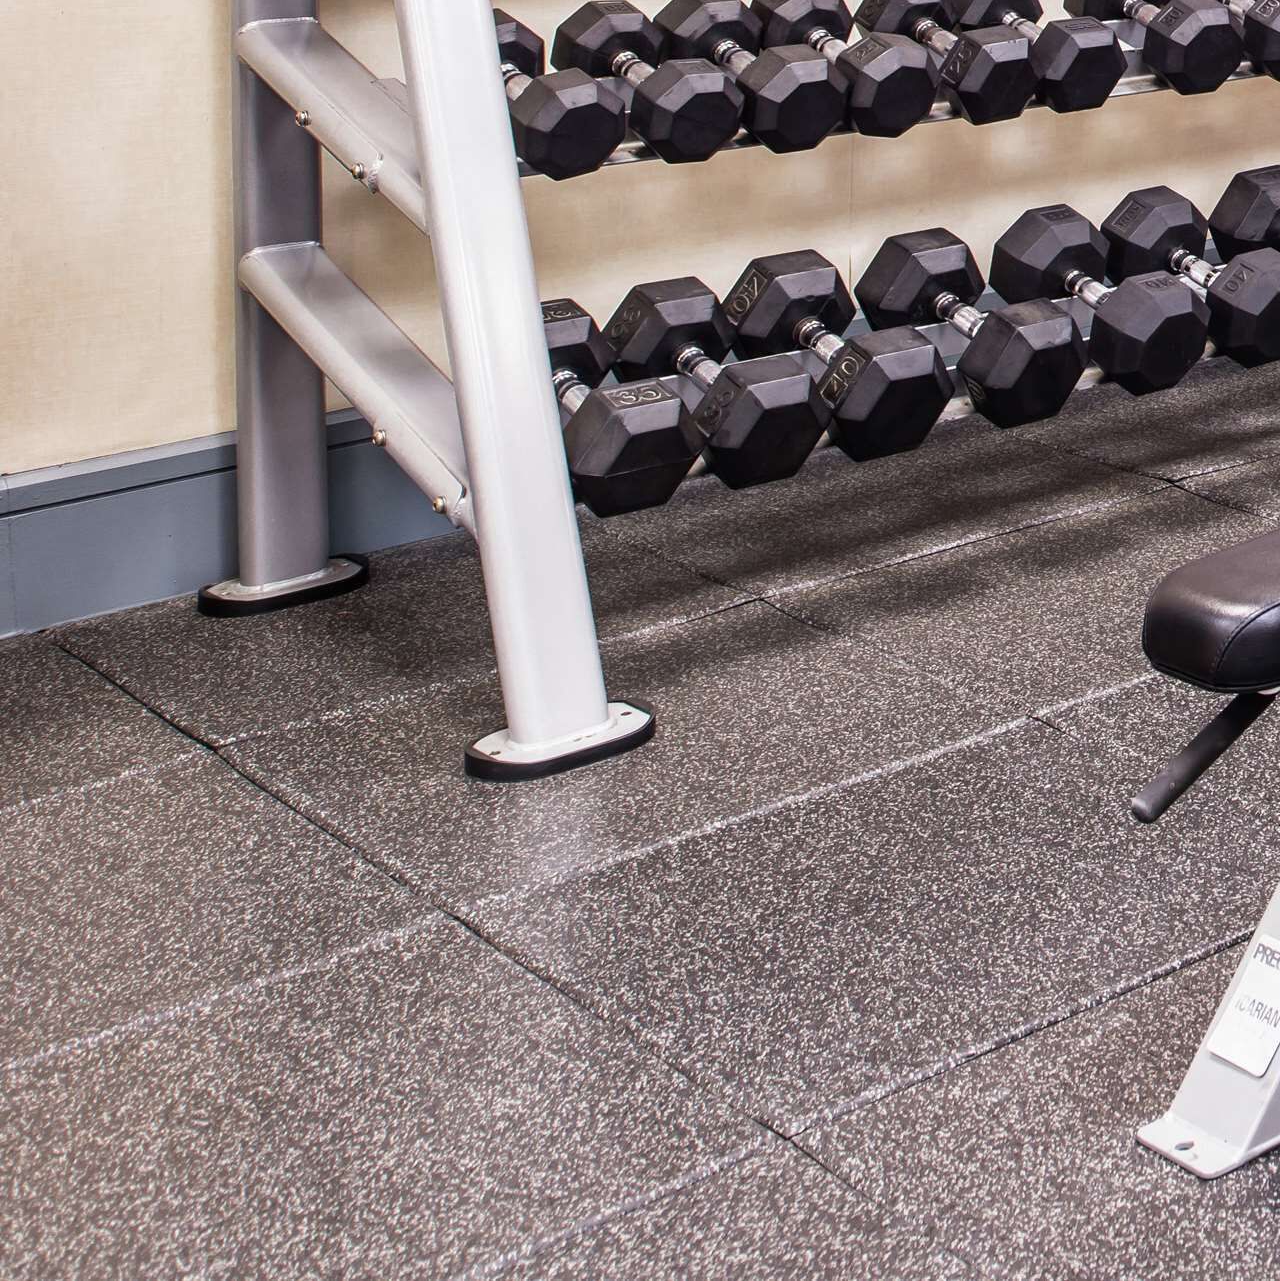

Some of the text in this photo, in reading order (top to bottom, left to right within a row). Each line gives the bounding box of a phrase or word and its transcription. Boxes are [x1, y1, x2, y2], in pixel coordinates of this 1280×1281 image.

[730, 274, 760, 318] 40
[1222, 265, 1249, 295] 40
[821, 354, 860, 399] 40
[618, 385, 664, 406] 35
